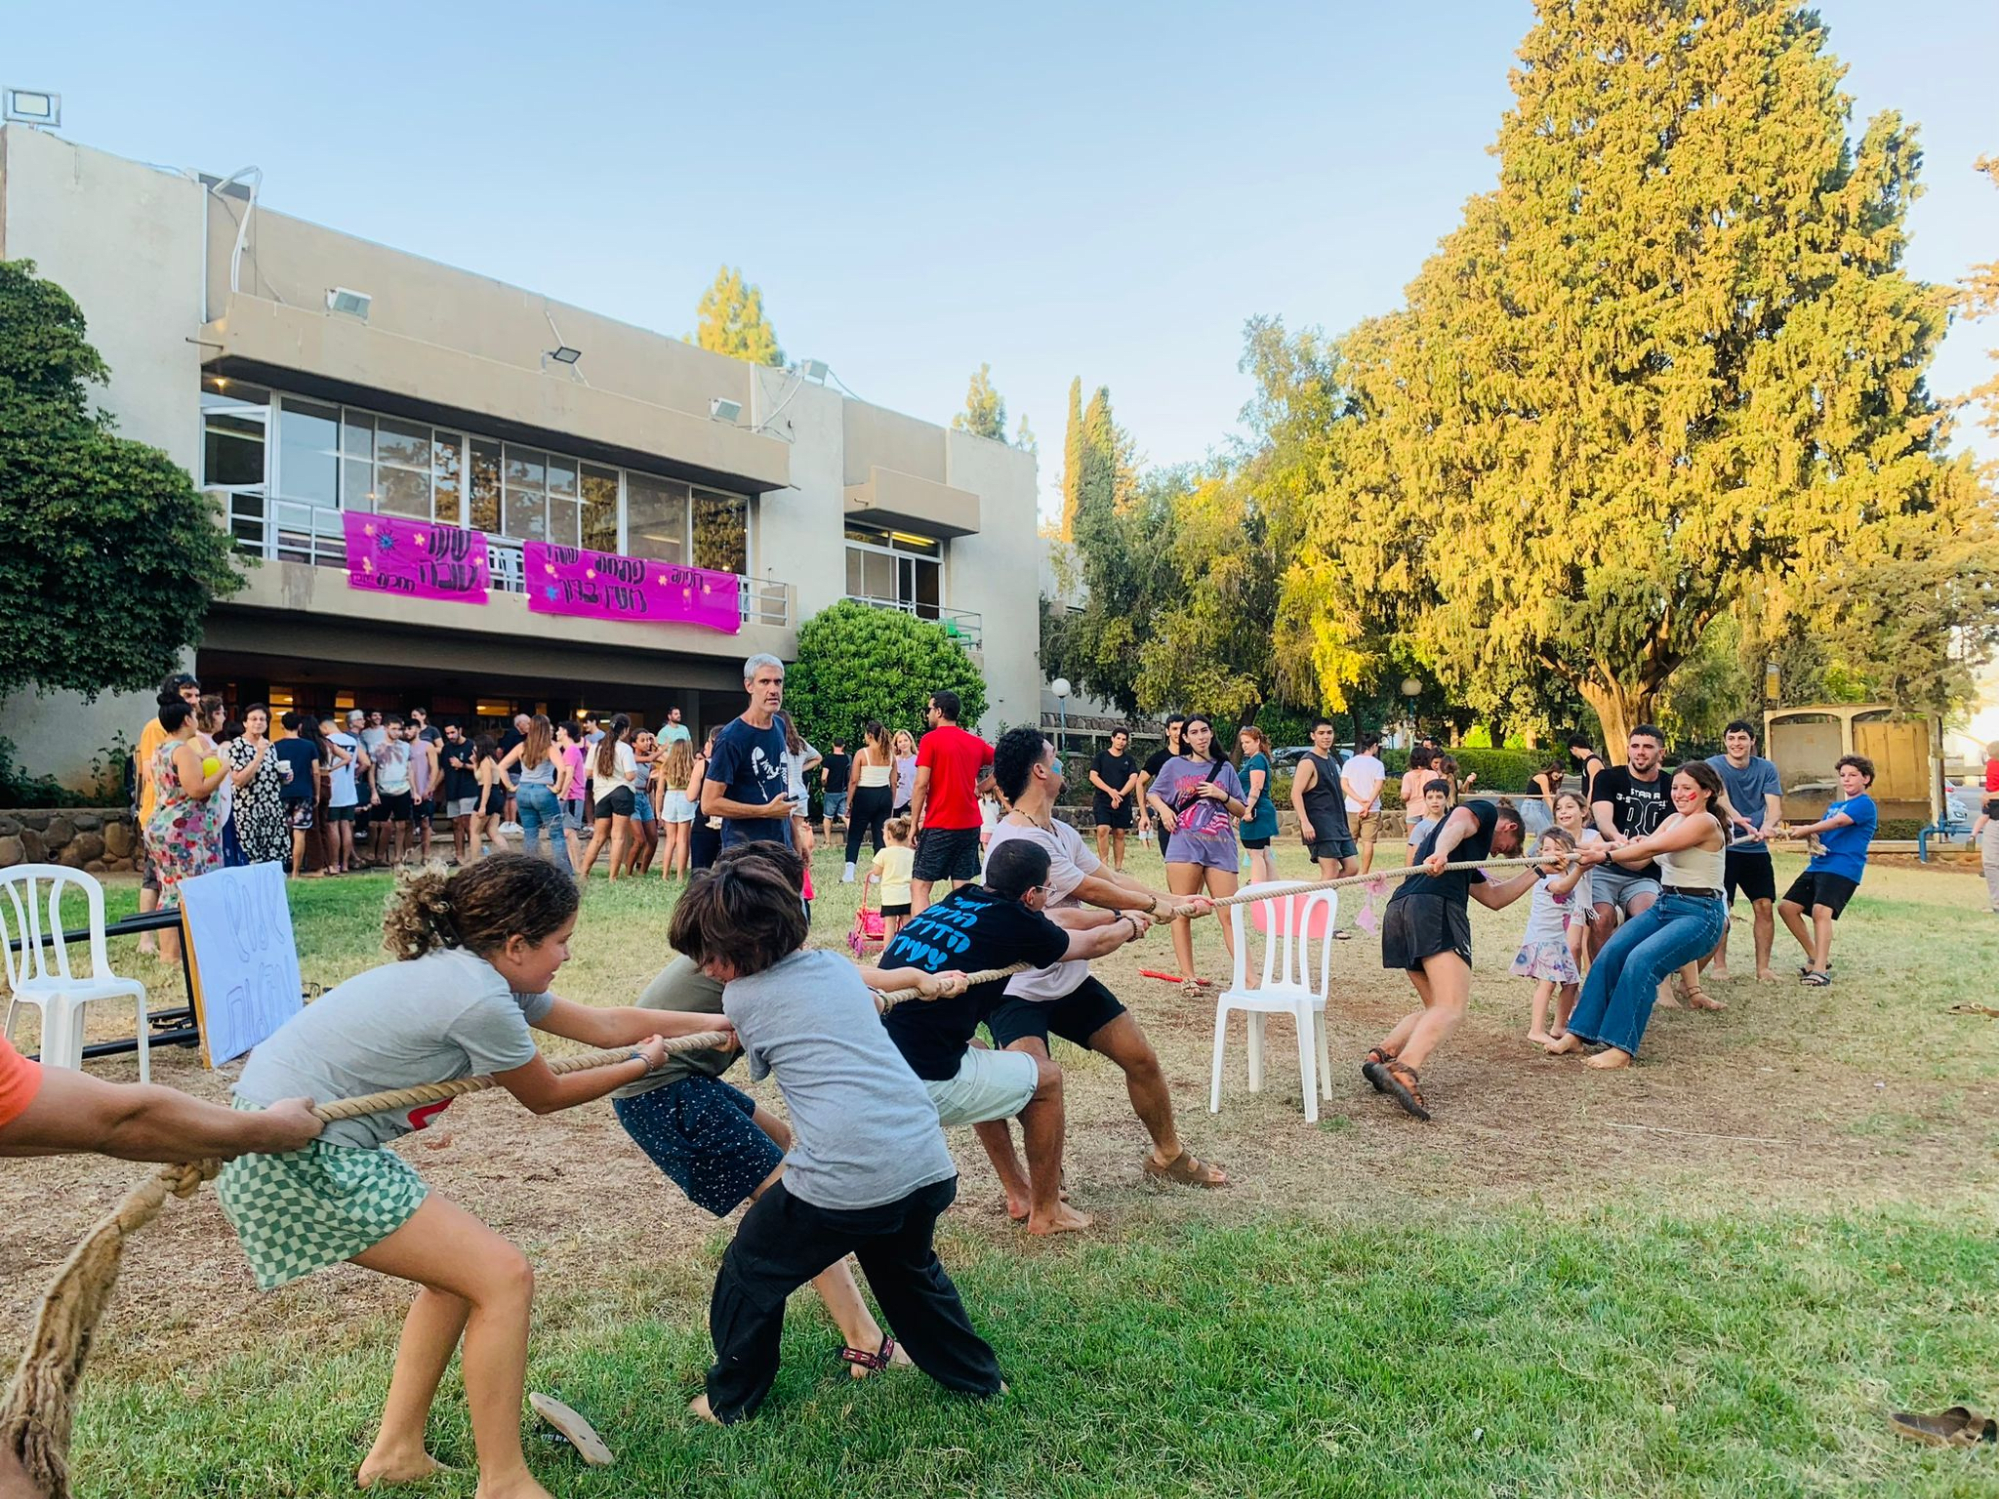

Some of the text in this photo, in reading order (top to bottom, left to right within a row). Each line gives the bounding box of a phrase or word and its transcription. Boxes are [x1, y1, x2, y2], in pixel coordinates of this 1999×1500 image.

[428, 525, 471, 561] שנה
[418, 559, 478, 592] טובה
[558, 578, 600, 604] ברוך
